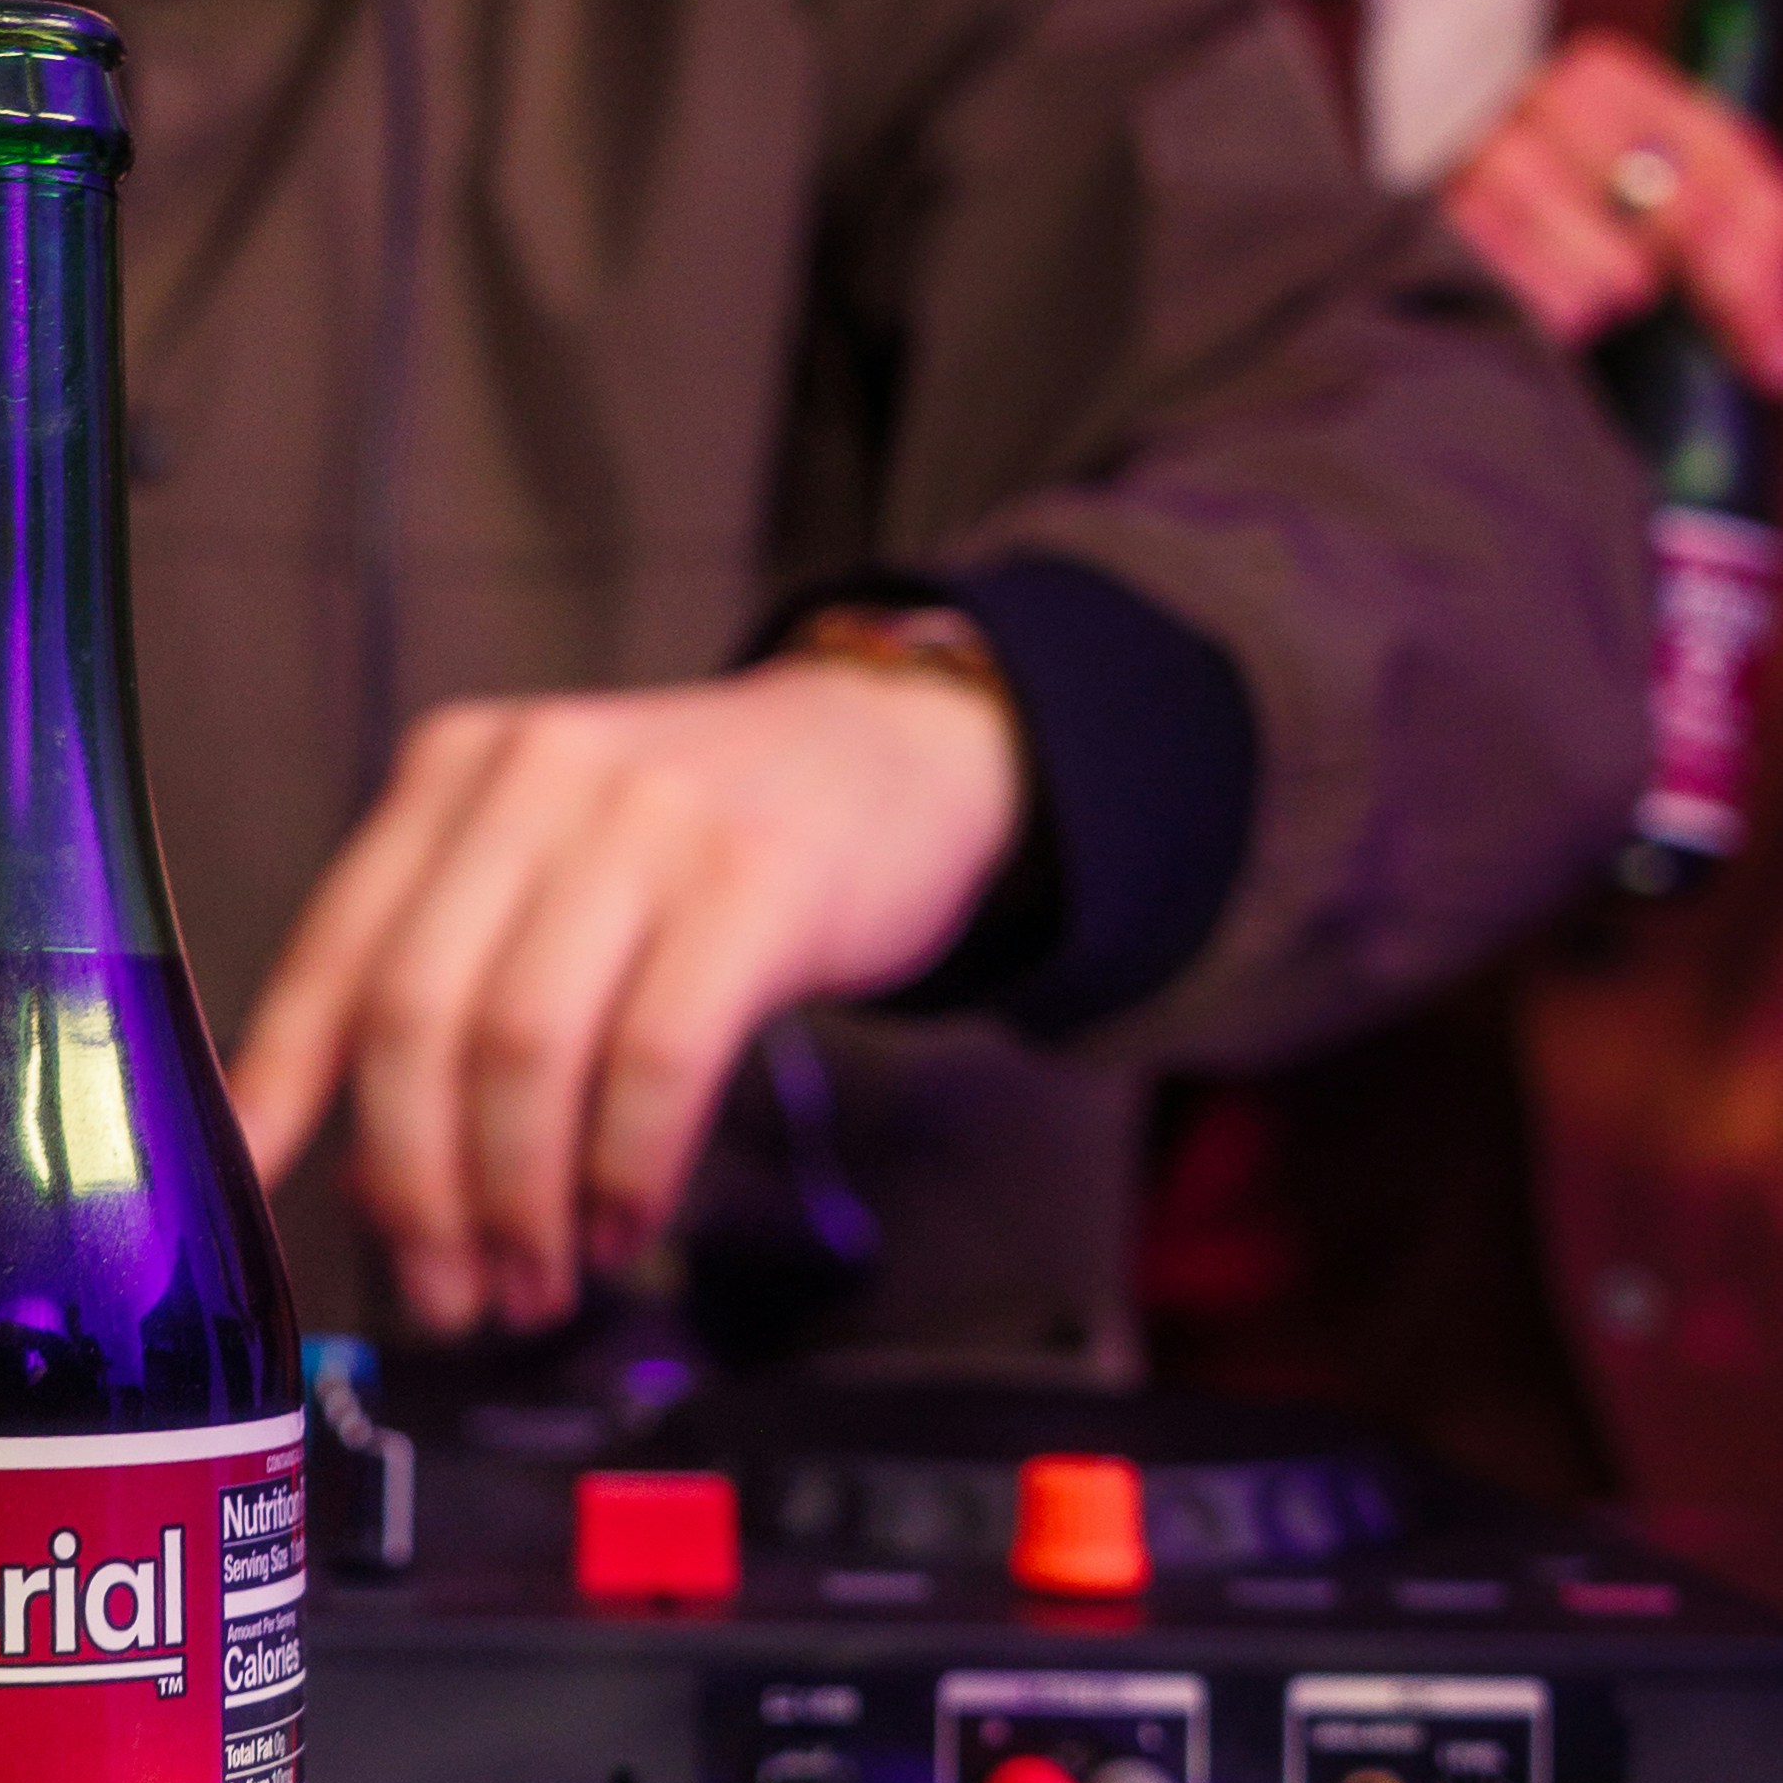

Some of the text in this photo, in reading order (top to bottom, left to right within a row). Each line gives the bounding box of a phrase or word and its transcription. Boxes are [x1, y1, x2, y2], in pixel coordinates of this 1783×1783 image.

[224, 1546, 268, 1584] Serving
[224, 1634, 300, 1692] Calories
[157, 1677, 185, 1696] TM
[225, 1738, 256, 1769] Total
[257, 1735, 273, 1763] Fat
